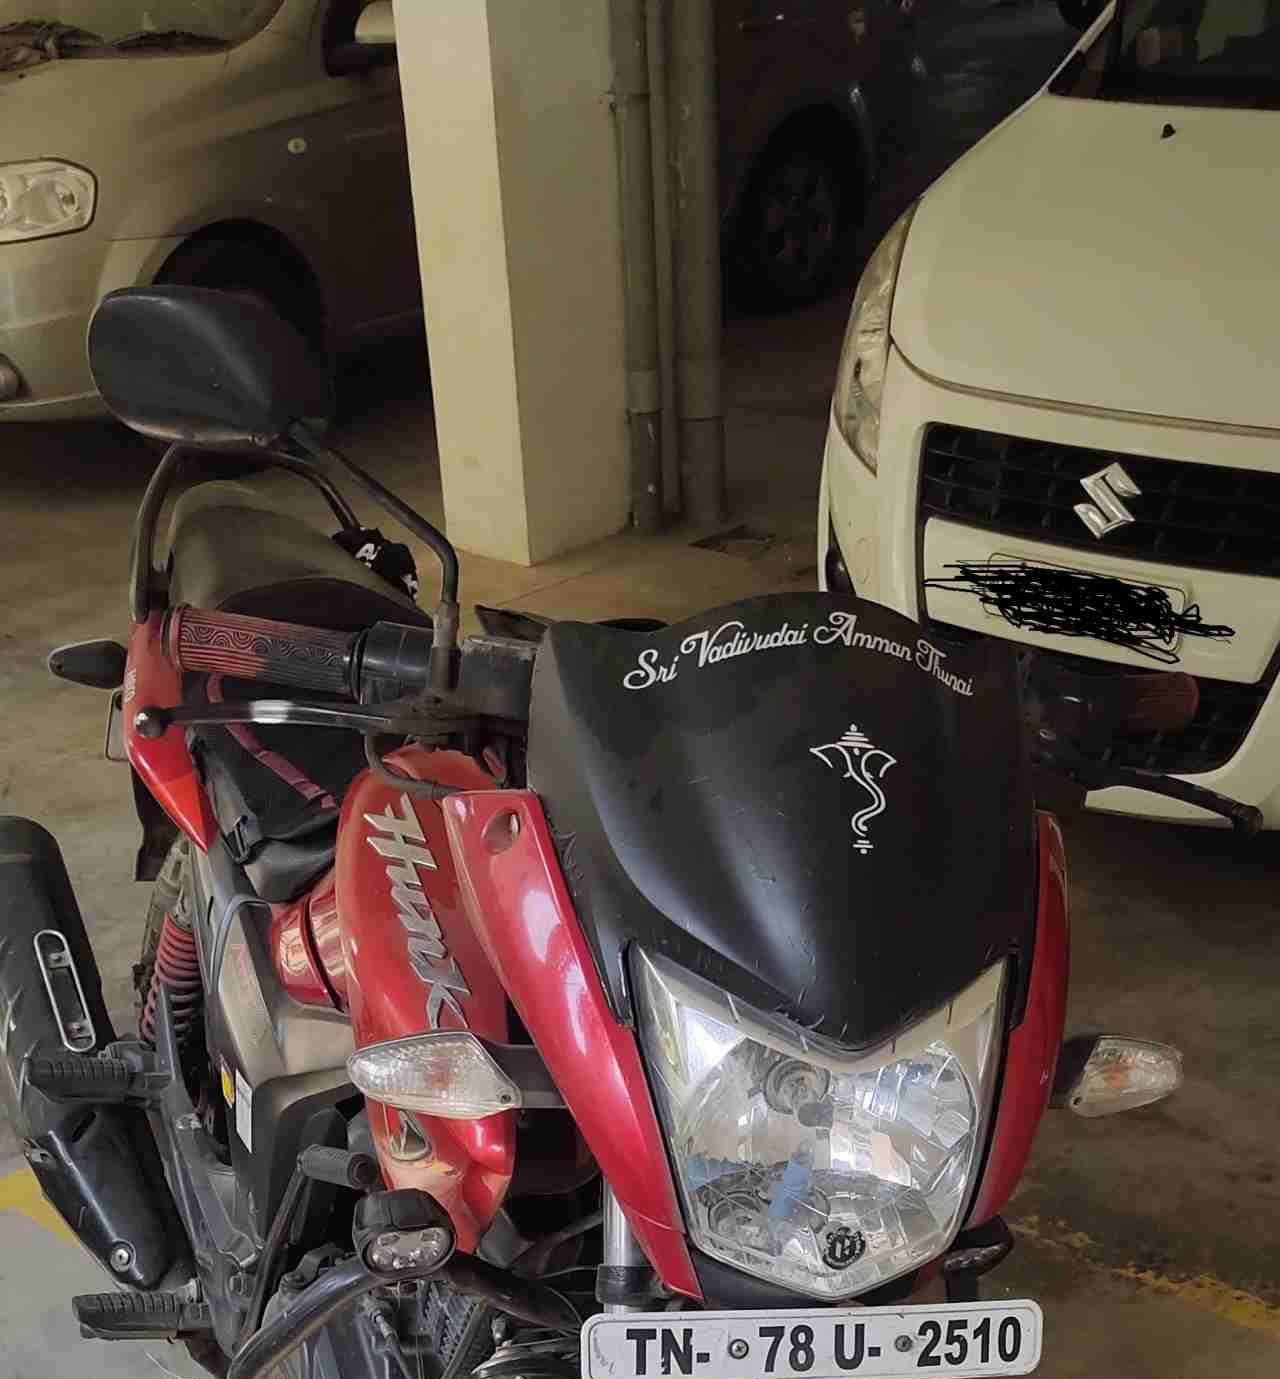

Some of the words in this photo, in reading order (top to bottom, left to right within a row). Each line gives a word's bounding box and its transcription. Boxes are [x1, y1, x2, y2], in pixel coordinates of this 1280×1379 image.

[623, 650, 678, 690] Sri
[680, 621, 808, 668] Vadivudai
[813, 612, 913, 661] Amman
[914, 639, 974, 696] Thunai
[758, 1324, 815, 1373] 78
[916, 1316, 1023, 1368] 2510
